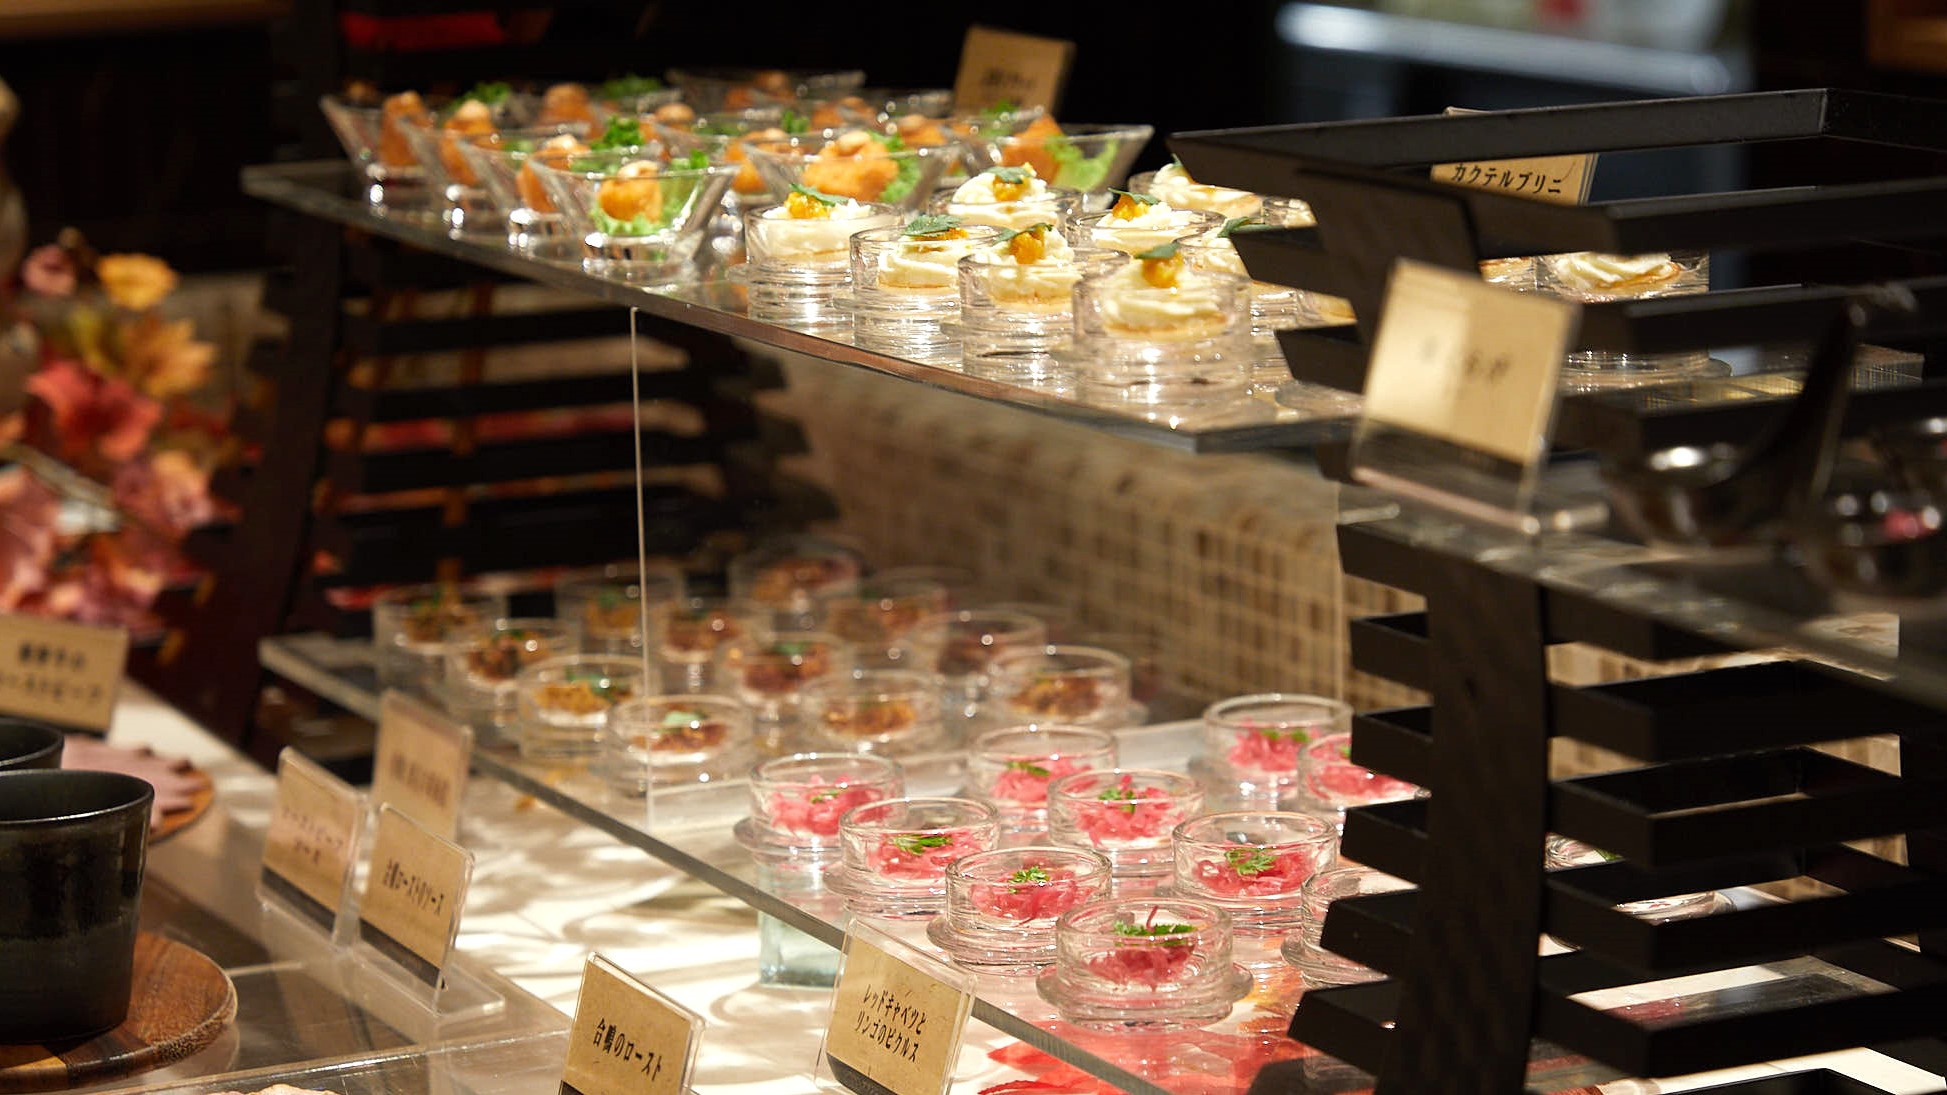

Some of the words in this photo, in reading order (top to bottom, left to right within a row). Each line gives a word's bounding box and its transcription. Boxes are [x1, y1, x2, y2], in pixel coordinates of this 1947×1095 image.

[863, 984, 926, 1035] レッドキャベツと
[855, 1010, 919, 1063] リンゴのピクルス
